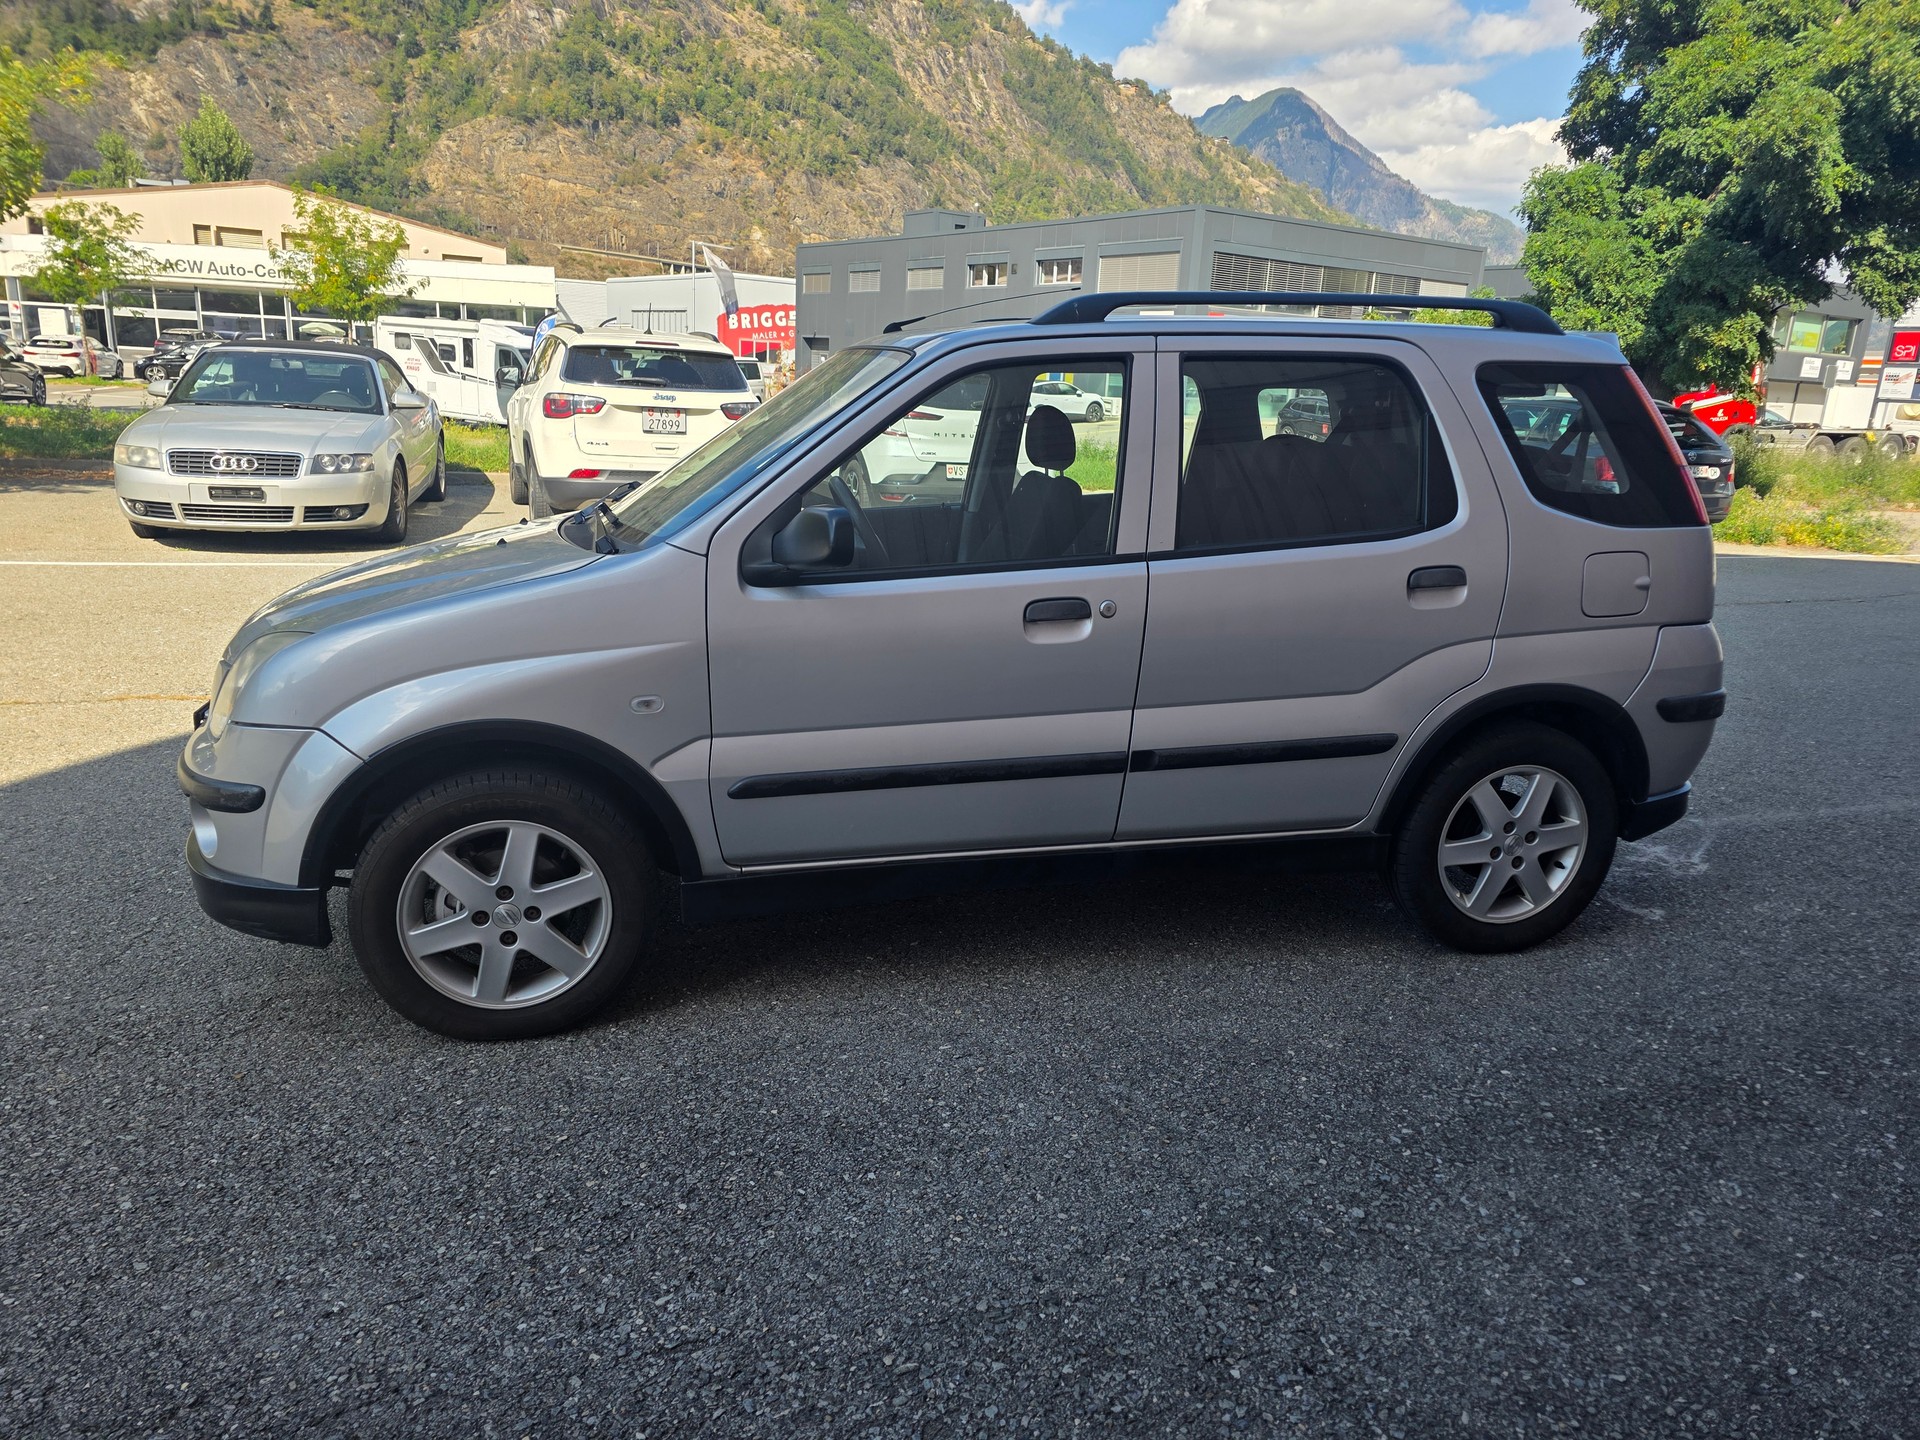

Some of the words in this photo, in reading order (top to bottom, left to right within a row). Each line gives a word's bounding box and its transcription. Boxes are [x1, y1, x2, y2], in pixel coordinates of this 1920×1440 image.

[752, 331, 778, 340] MALER
[1894, 345, 1916, 357] SPI
[652, 392, 677, 403] Jeep
[659, 408, 670, 418] VS
[648, 418, 681, 431] 27899
